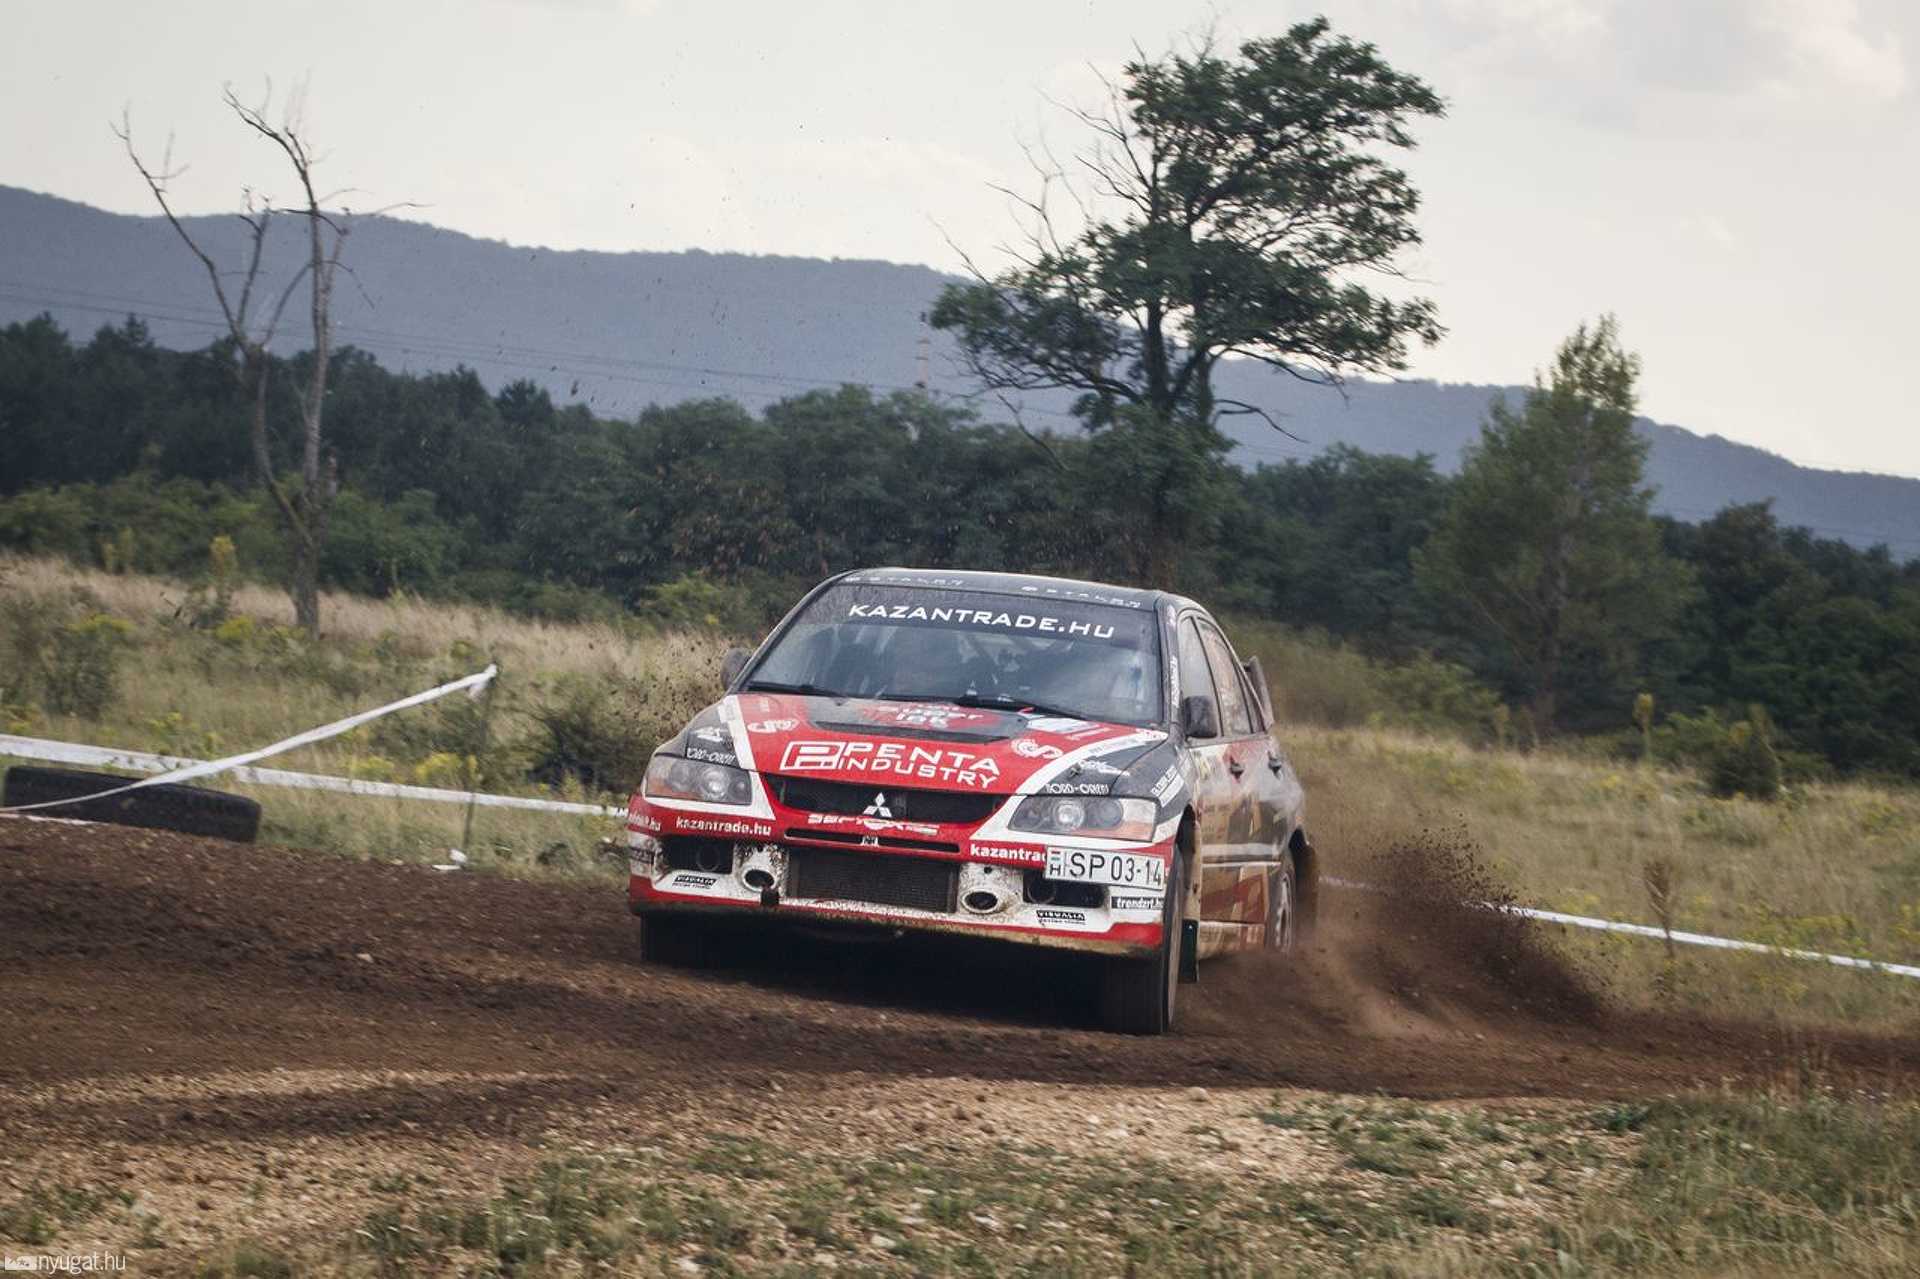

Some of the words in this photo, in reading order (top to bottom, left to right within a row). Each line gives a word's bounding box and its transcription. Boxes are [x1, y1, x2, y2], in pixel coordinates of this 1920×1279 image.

[848, 604, 1115, 639] KAZANTRADE.HU
[838, 755, 999, 789] INDUSTRY
[843, 741, 1000, 776] PENTA
[676, 815, 772, 836] kazantrade.hu
[969, 843, 1046, 863] kazantra
[1069, 852, 1105, 879] SP
[1110, 855, 1162, 886] 03-14
